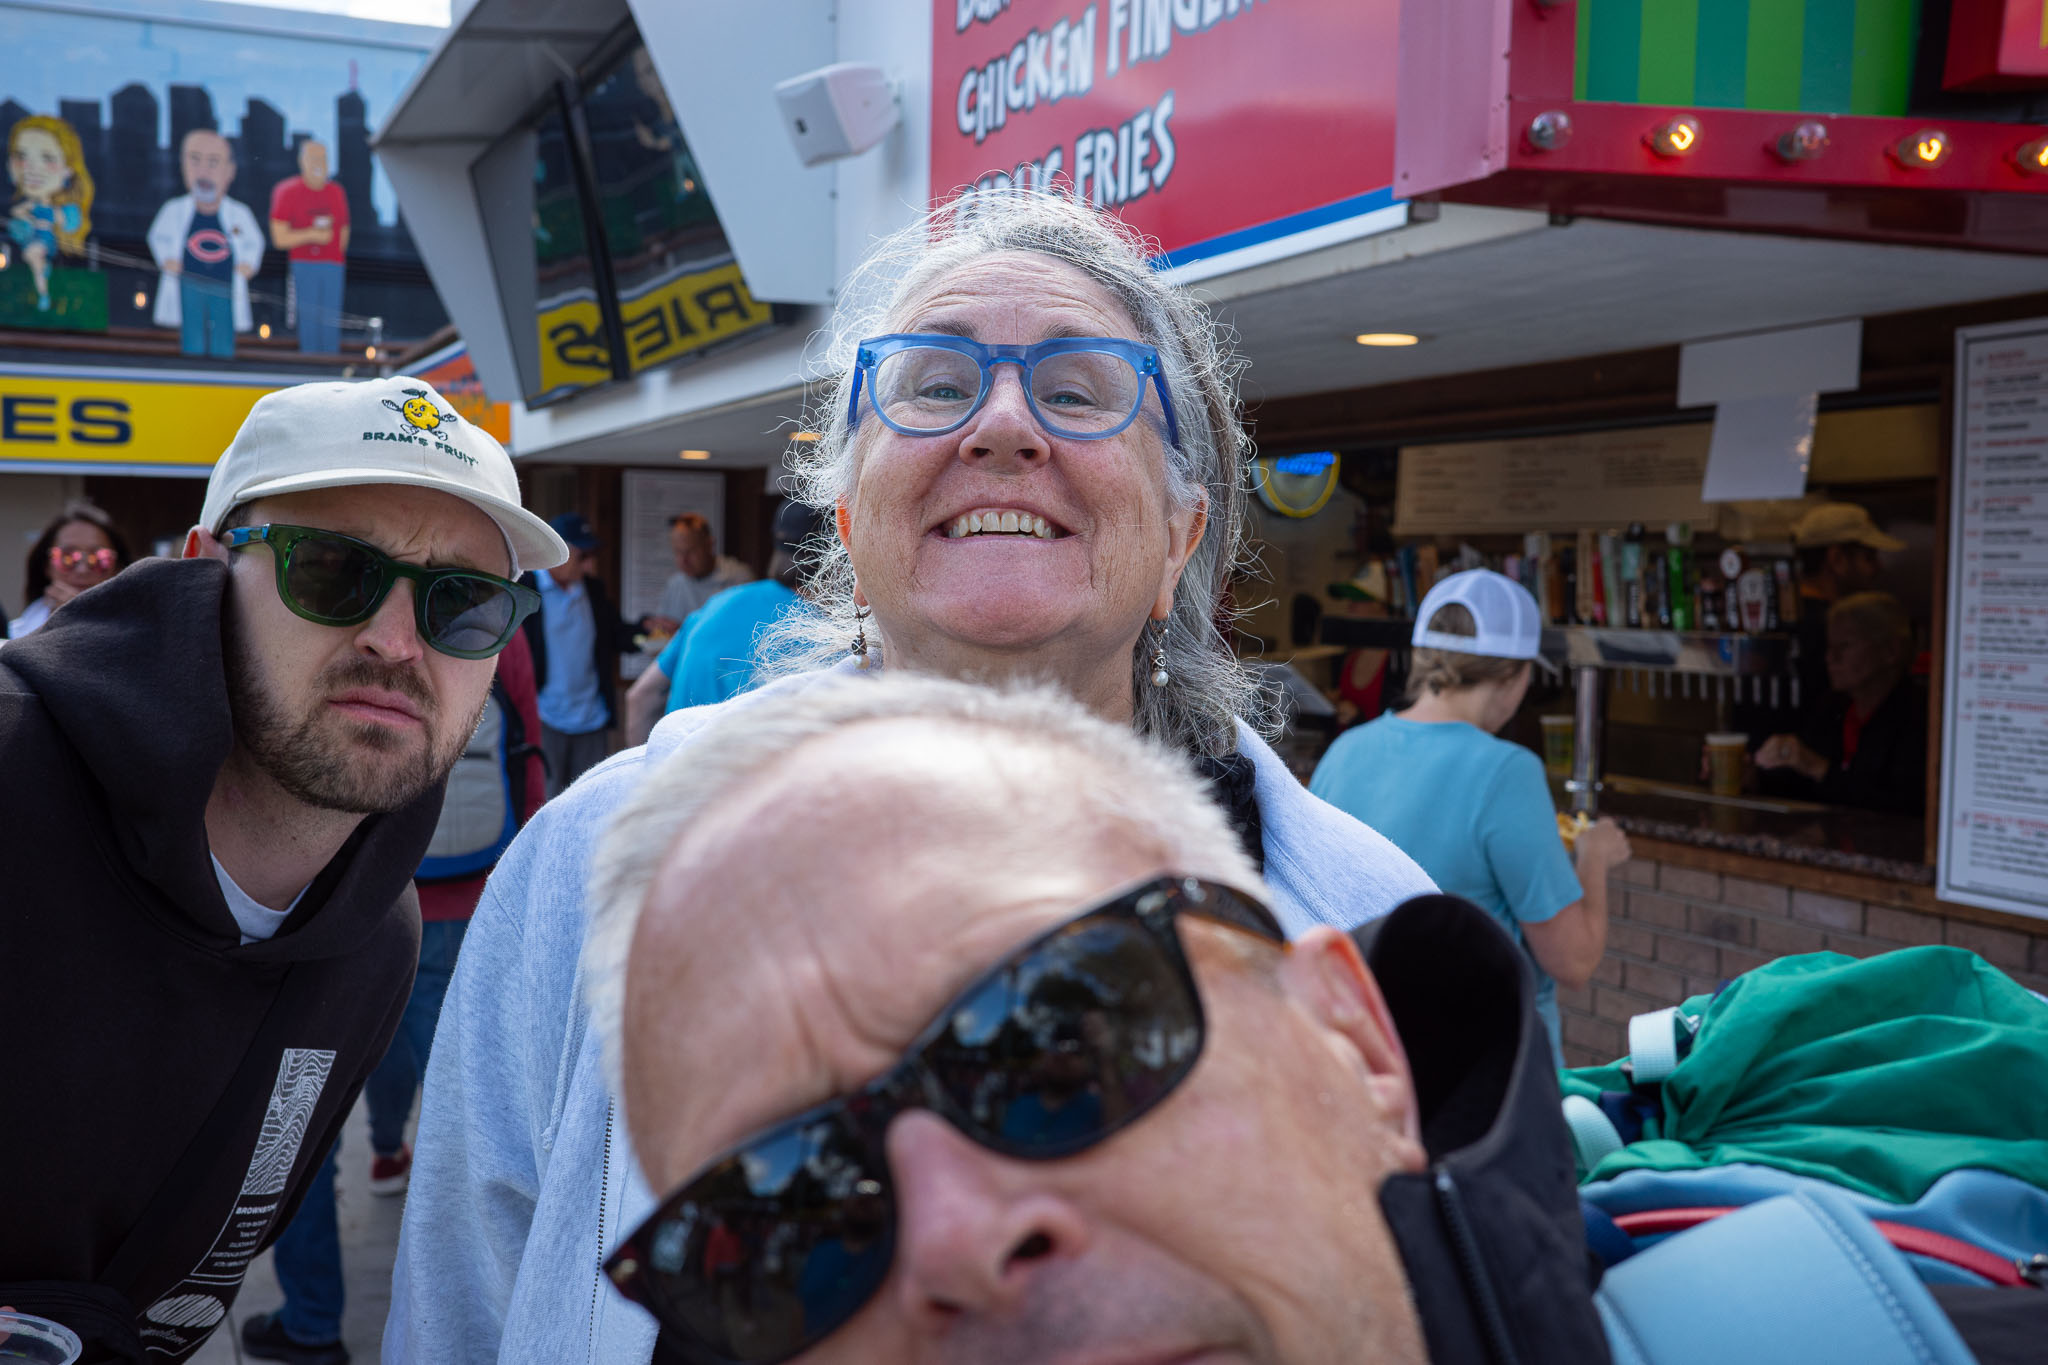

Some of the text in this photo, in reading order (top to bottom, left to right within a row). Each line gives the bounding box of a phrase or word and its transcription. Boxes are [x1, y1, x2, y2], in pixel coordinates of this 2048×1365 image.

[957, 3, 1096, 144] CHICKEN
[1074, 90, 1176, 208] FRIES
[187, 229, 231, 263] C
[362, 431, 476, 467] BRAM'S FRUIT
